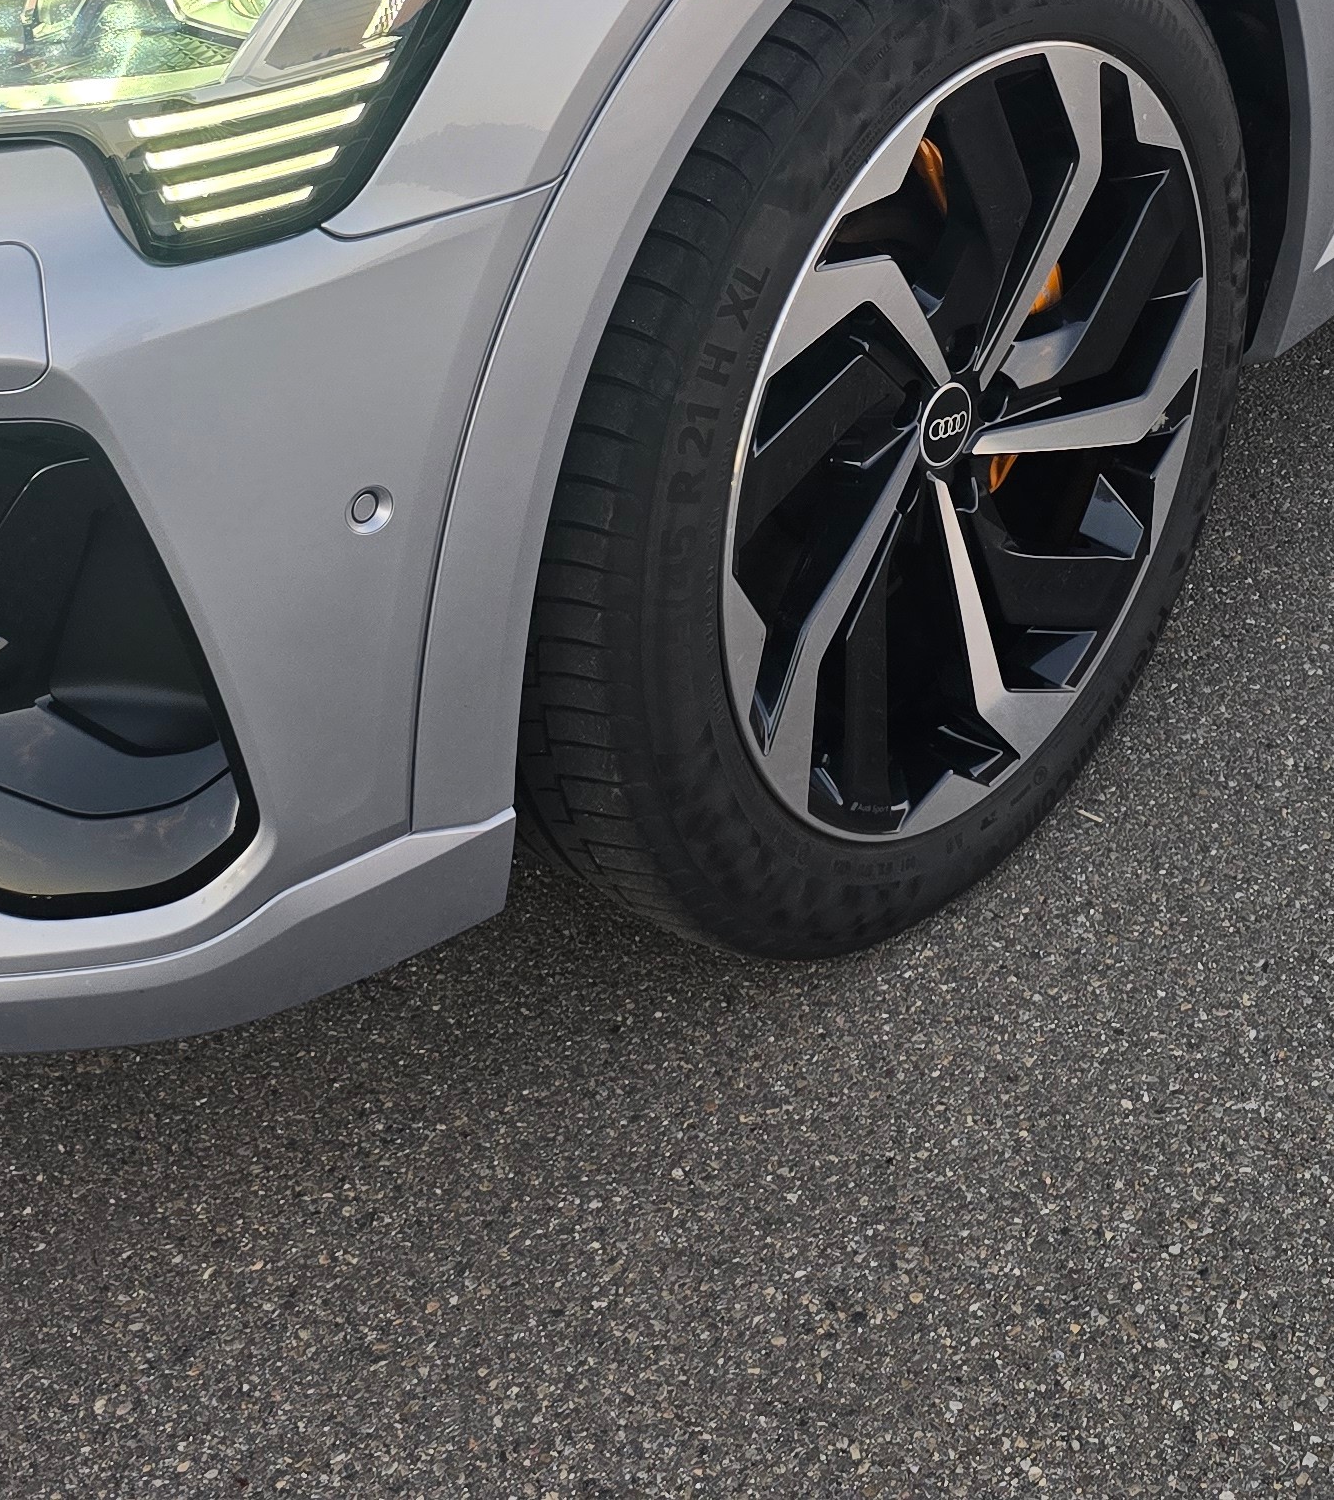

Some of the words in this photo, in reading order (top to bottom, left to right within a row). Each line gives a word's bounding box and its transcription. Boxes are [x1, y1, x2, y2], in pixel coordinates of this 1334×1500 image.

[715, 265, 771, 333] XL
[695, 340, 739, 389] H
[677, 401, 722, 459] 21
